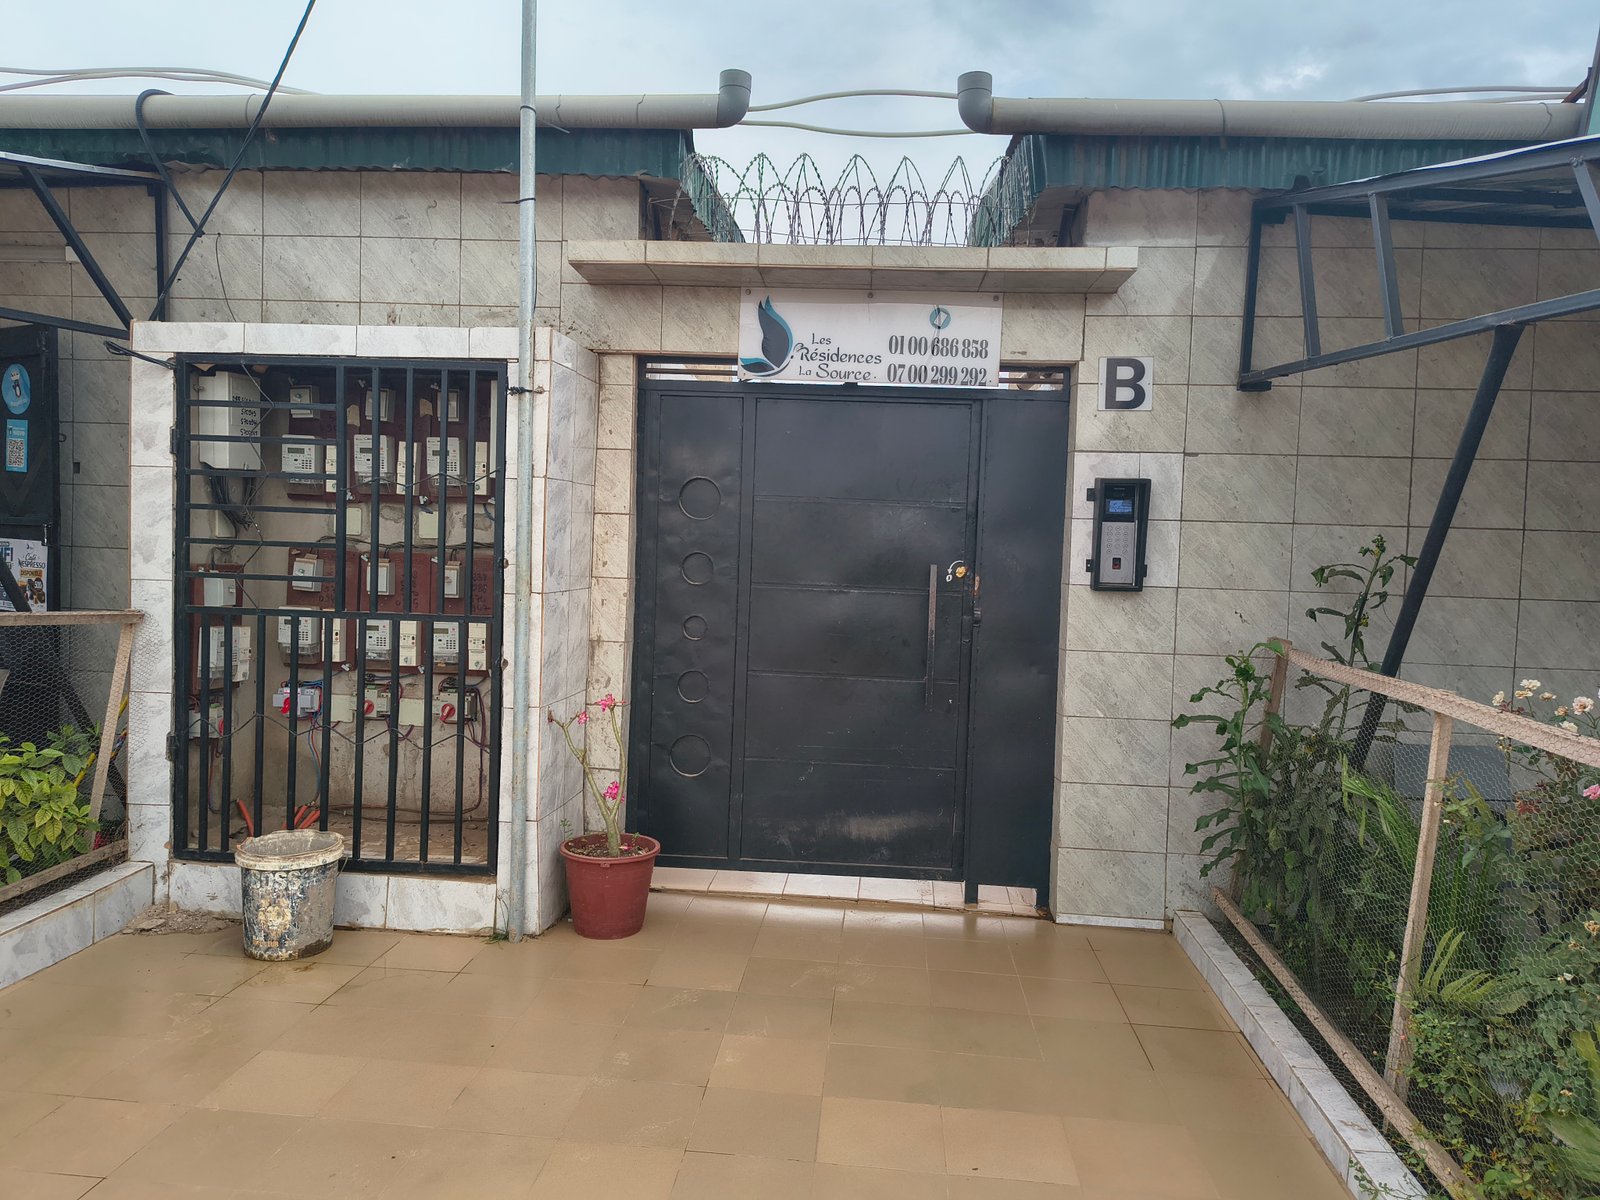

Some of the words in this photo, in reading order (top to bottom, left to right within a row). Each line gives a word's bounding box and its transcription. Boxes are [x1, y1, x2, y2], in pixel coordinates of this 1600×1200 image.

[811, 332, 832, 345] Les
[888, 334, 905, 355] 01
[908, 336, 928, 356] 00
[931, 336, 959, 357] 686
[961, 338, 989, 359] 858
[795, 344, 882, 364] Résidences
[799, 365, 812, 376] La
[887, 362, 906, 383] 07
[907, 364, 928, 384] 00
[930, 365, 959, 385] 299
[1104, 357, 1146, 410] B
